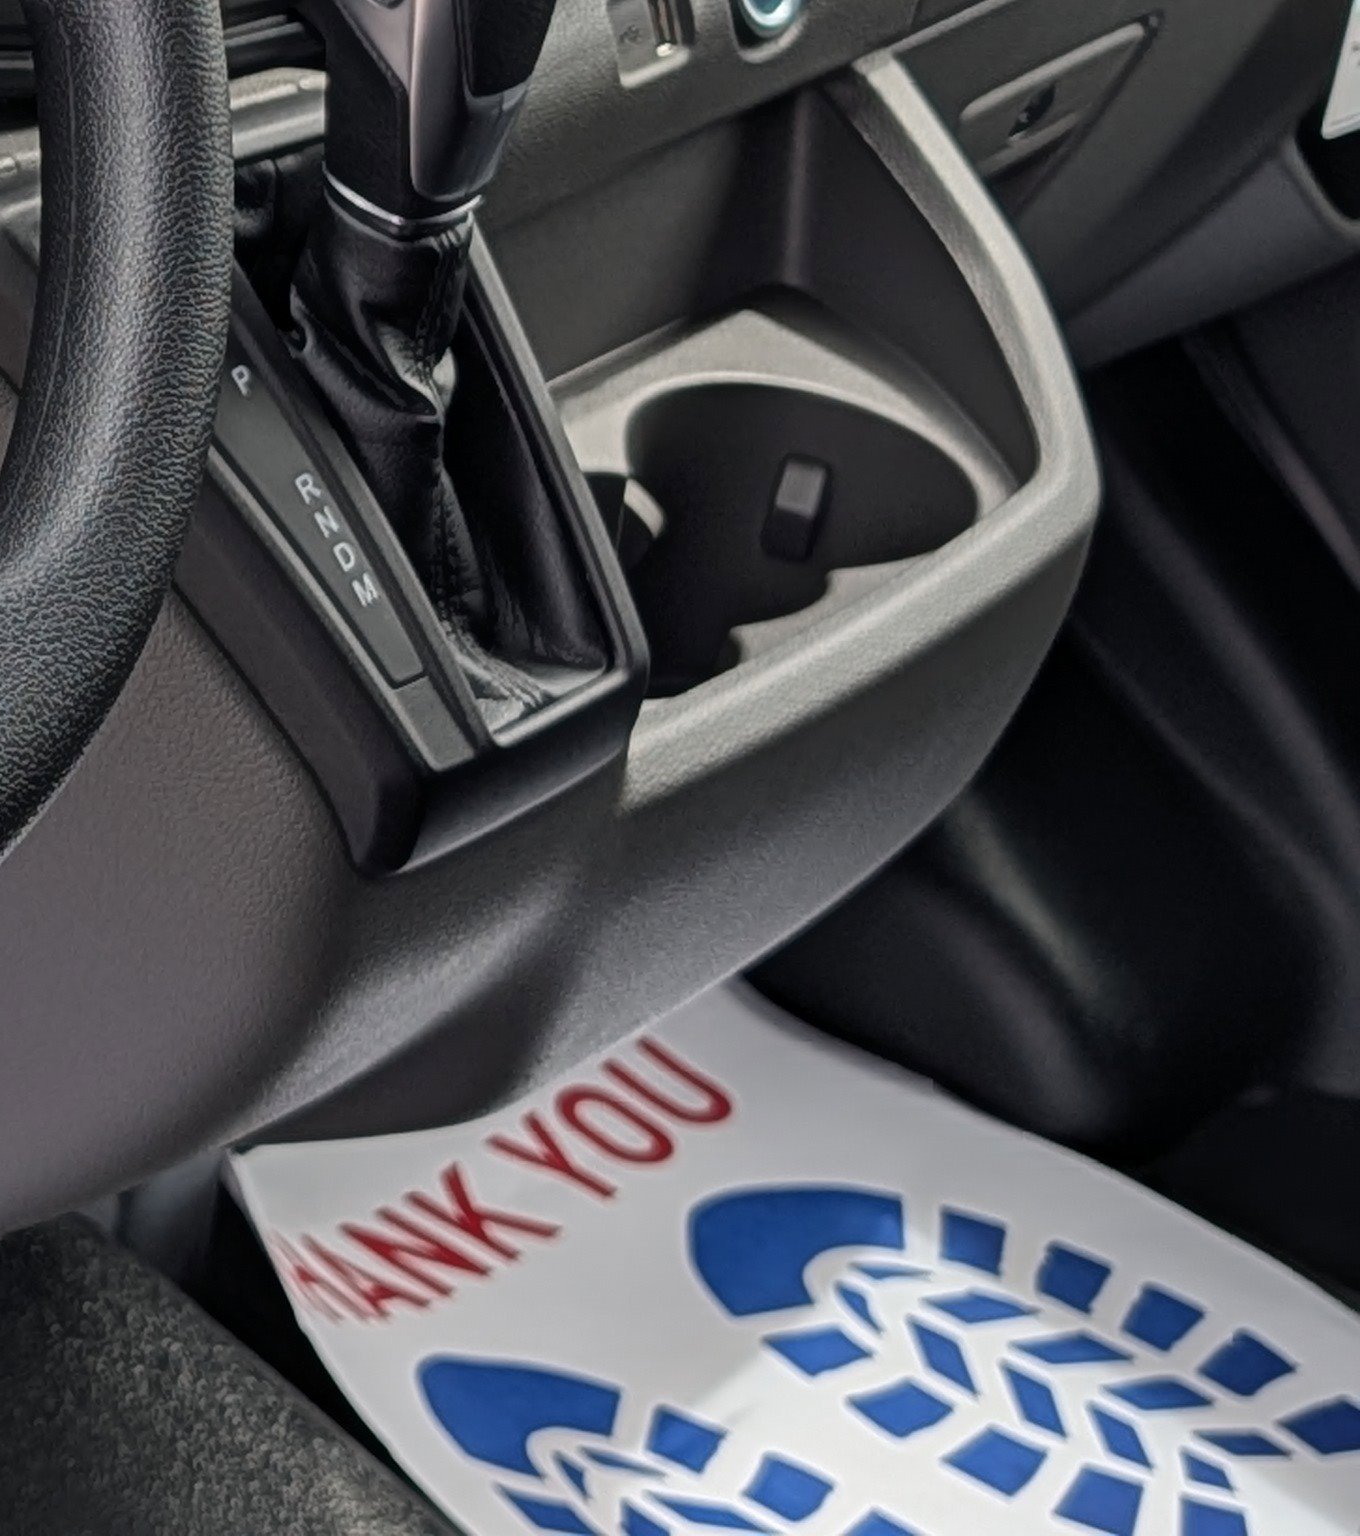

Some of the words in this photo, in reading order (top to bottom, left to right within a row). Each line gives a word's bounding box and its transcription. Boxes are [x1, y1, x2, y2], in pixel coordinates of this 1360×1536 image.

[231, 364, 253, 397] P
[293, 471, 322, 505] R
[314, 506, 340, 539] N
[333, 541, 357, 573] D
[351, 573, 379, 607] M
[485, 1034, 734, 1201] YOU
